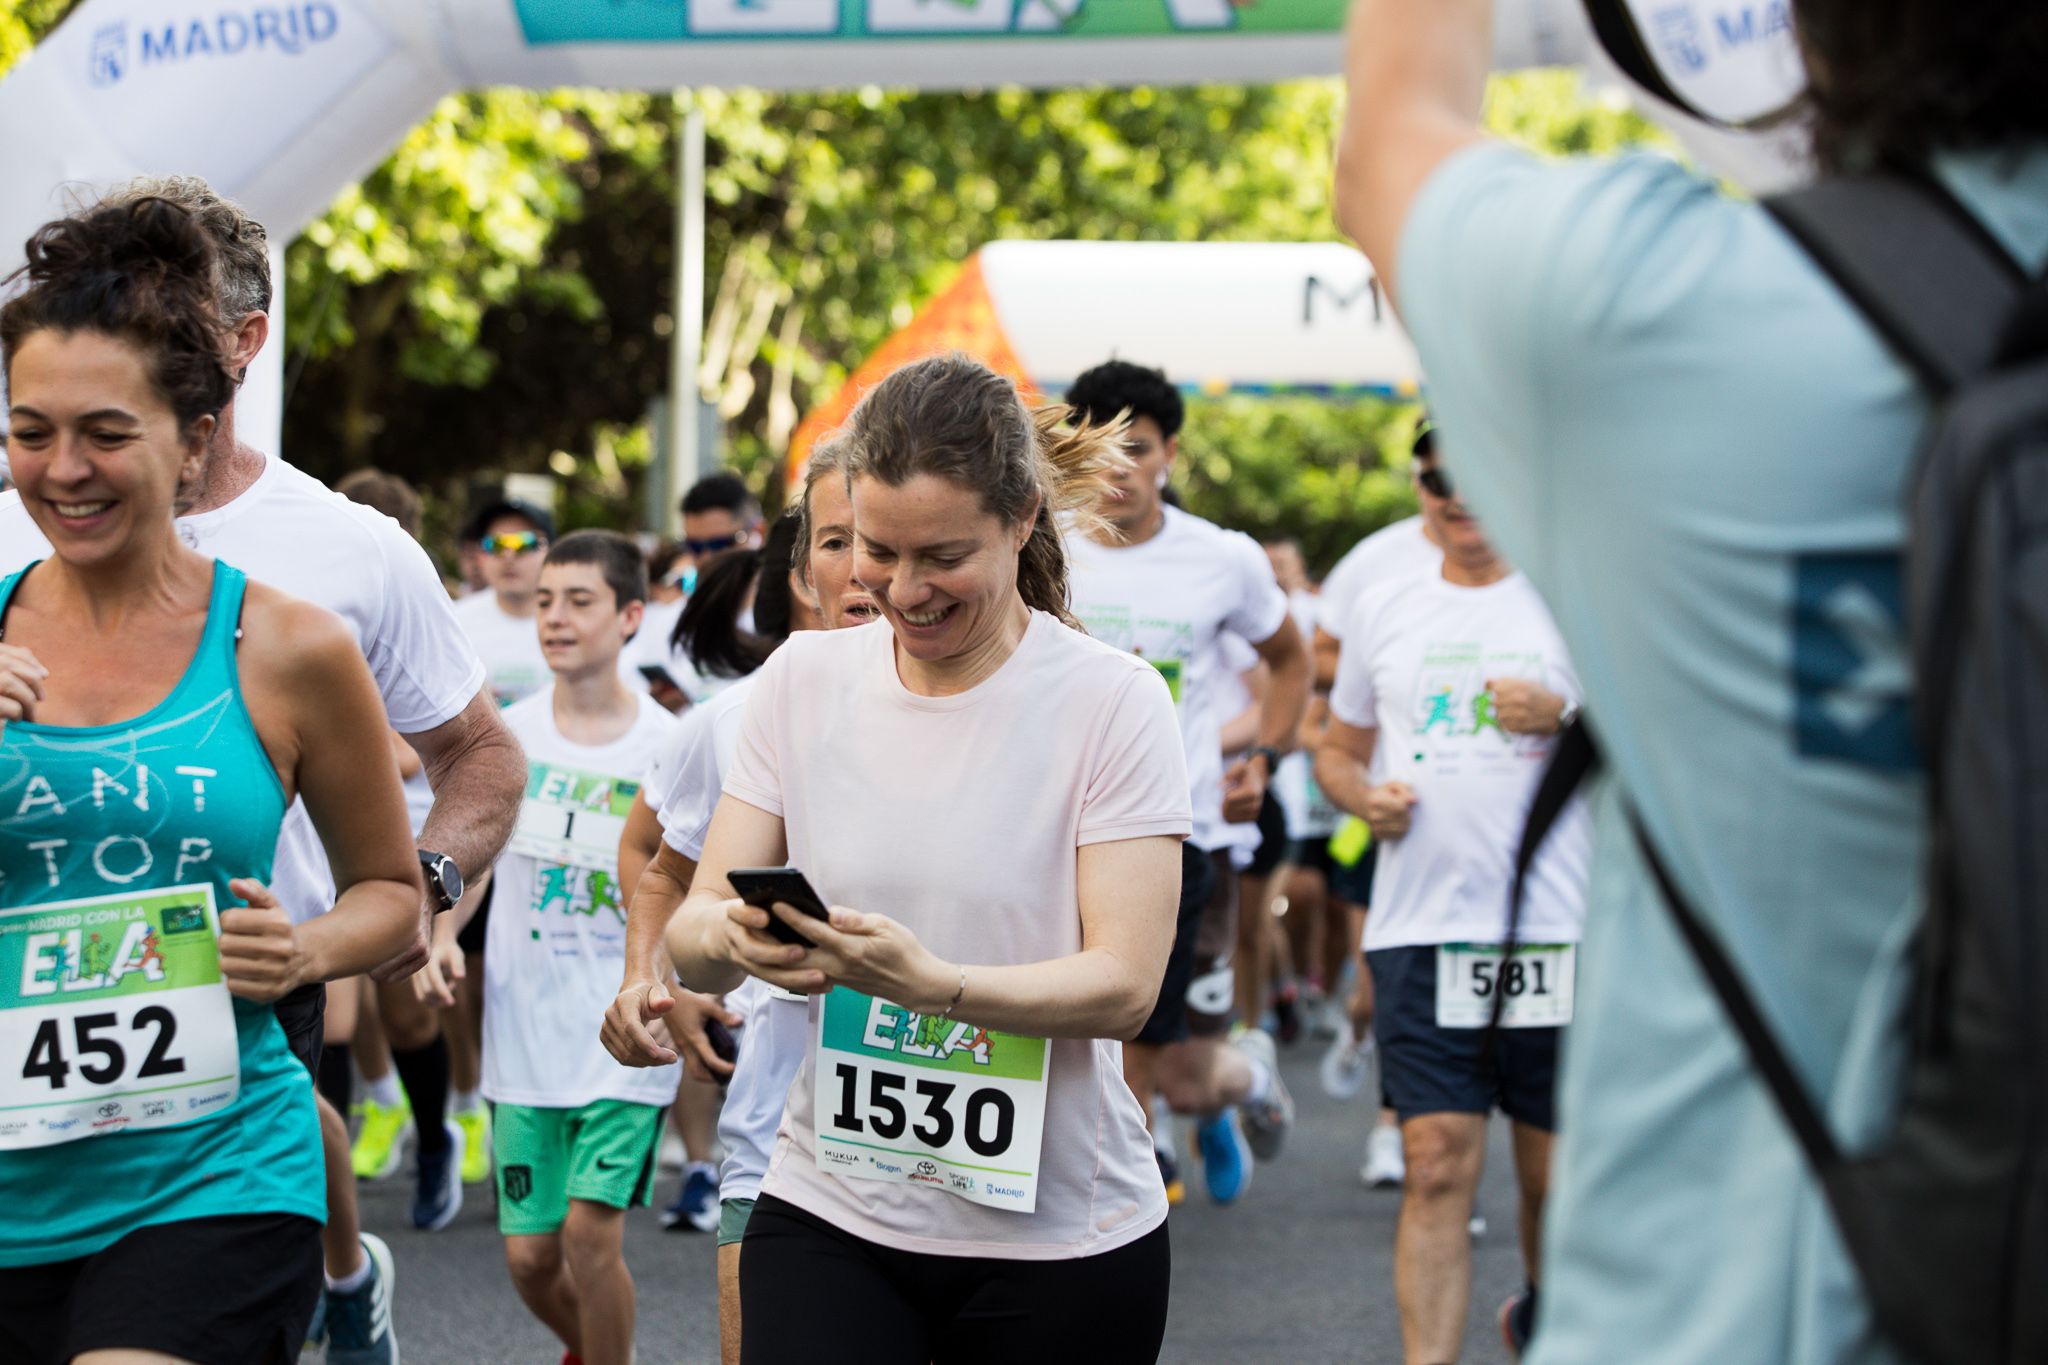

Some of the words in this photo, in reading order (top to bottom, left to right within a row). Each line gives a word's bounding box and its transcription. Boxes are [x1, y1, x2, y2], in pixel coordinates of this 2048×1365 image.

[140, 3, 338, 61] MADRID
[16, 764, 218, 813] ANT
[563, 812, 575, 839] 1
[0, 835, 213, 888] TOP
[28, 913, 82, 932] MADRID
[84, 909, 121, 926] CON
[123, 905, 146, 920] LA
[19, 920, 167, 997] ELA
[1472, 960, 1549, 997] 581
[22, 1005, 187, 1090] 452
[861, 994, 991, 1065] ELA
[833, 1062, 1016, 1158] 1530
[824, 1150, 860, 1162] MUKUA
[876, 1161, 902, 1173] Biogen
[994, 1186, 1025, 1198] MADRID
